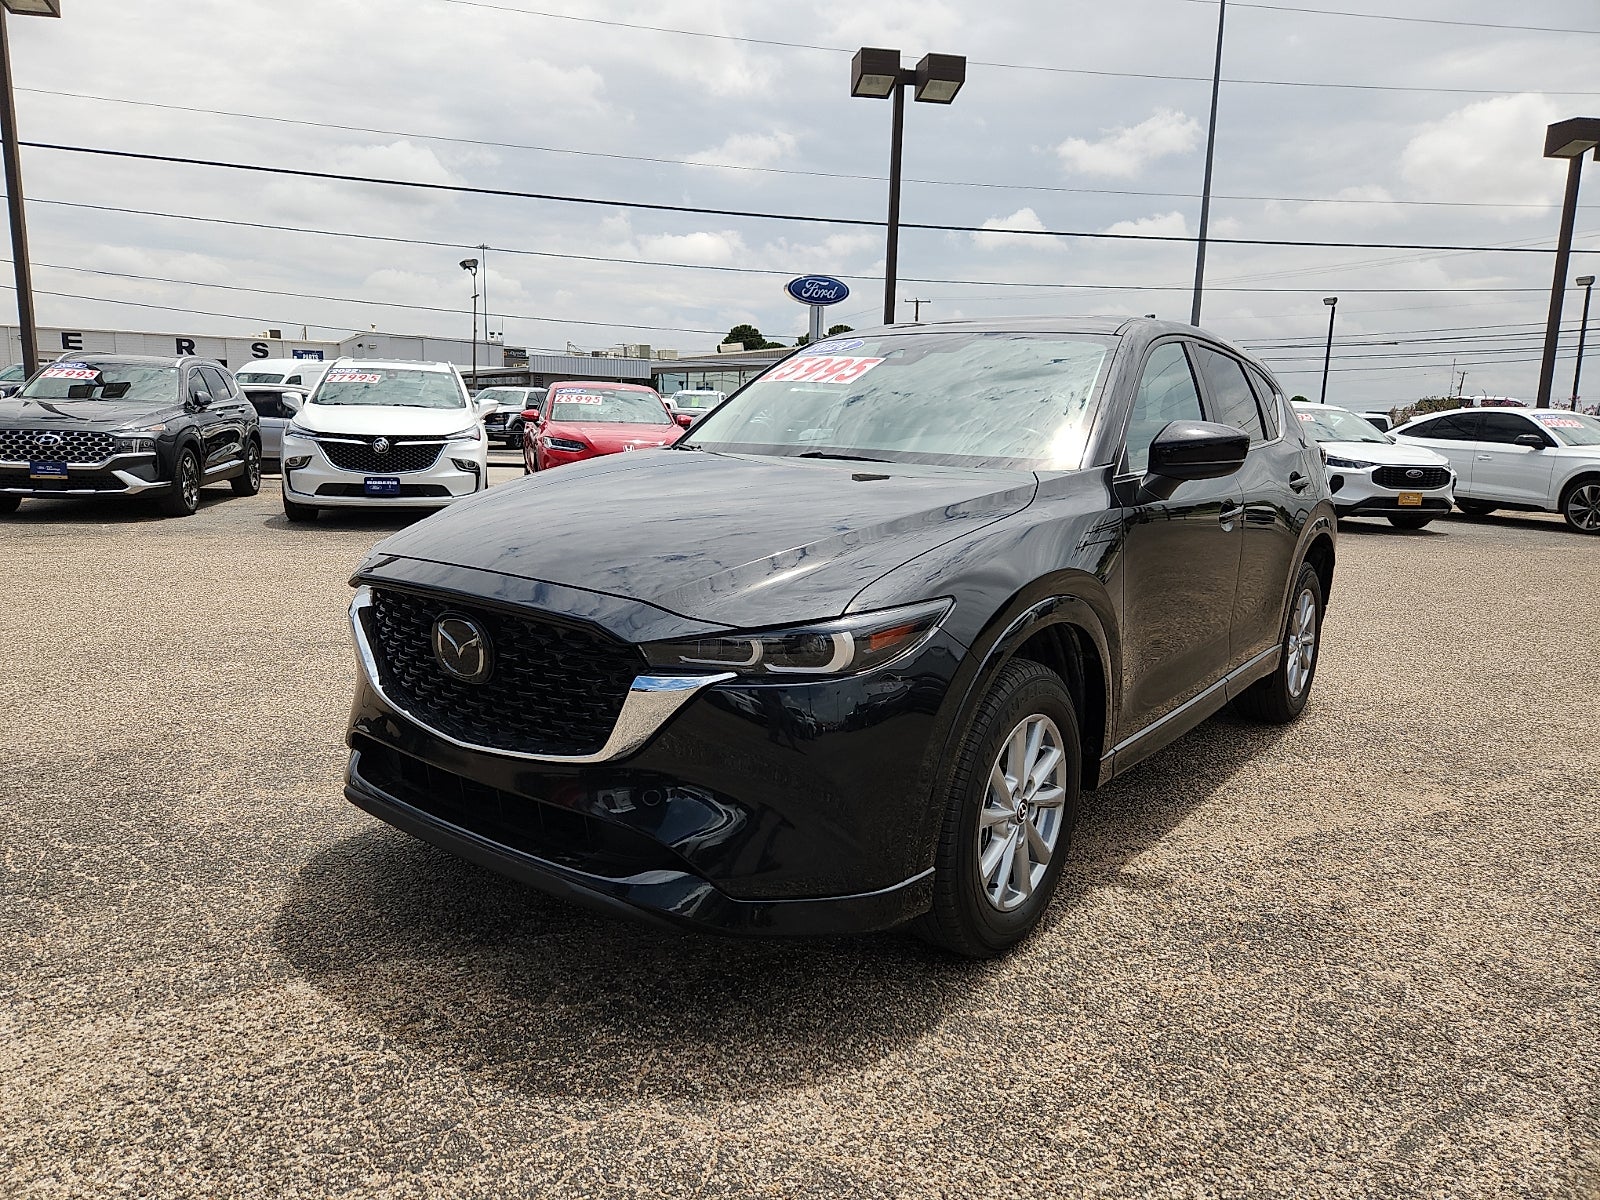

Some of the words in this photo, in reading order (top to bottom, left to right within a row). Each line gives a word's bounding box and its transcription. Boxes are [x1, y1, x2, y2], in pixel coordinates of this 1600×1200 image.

[801, 279, 838, 299] Ford
[41, 368, 98, 379] 27995
[326, 374, 379, 383] 27995
[556, 394, 601, 404] 28995
